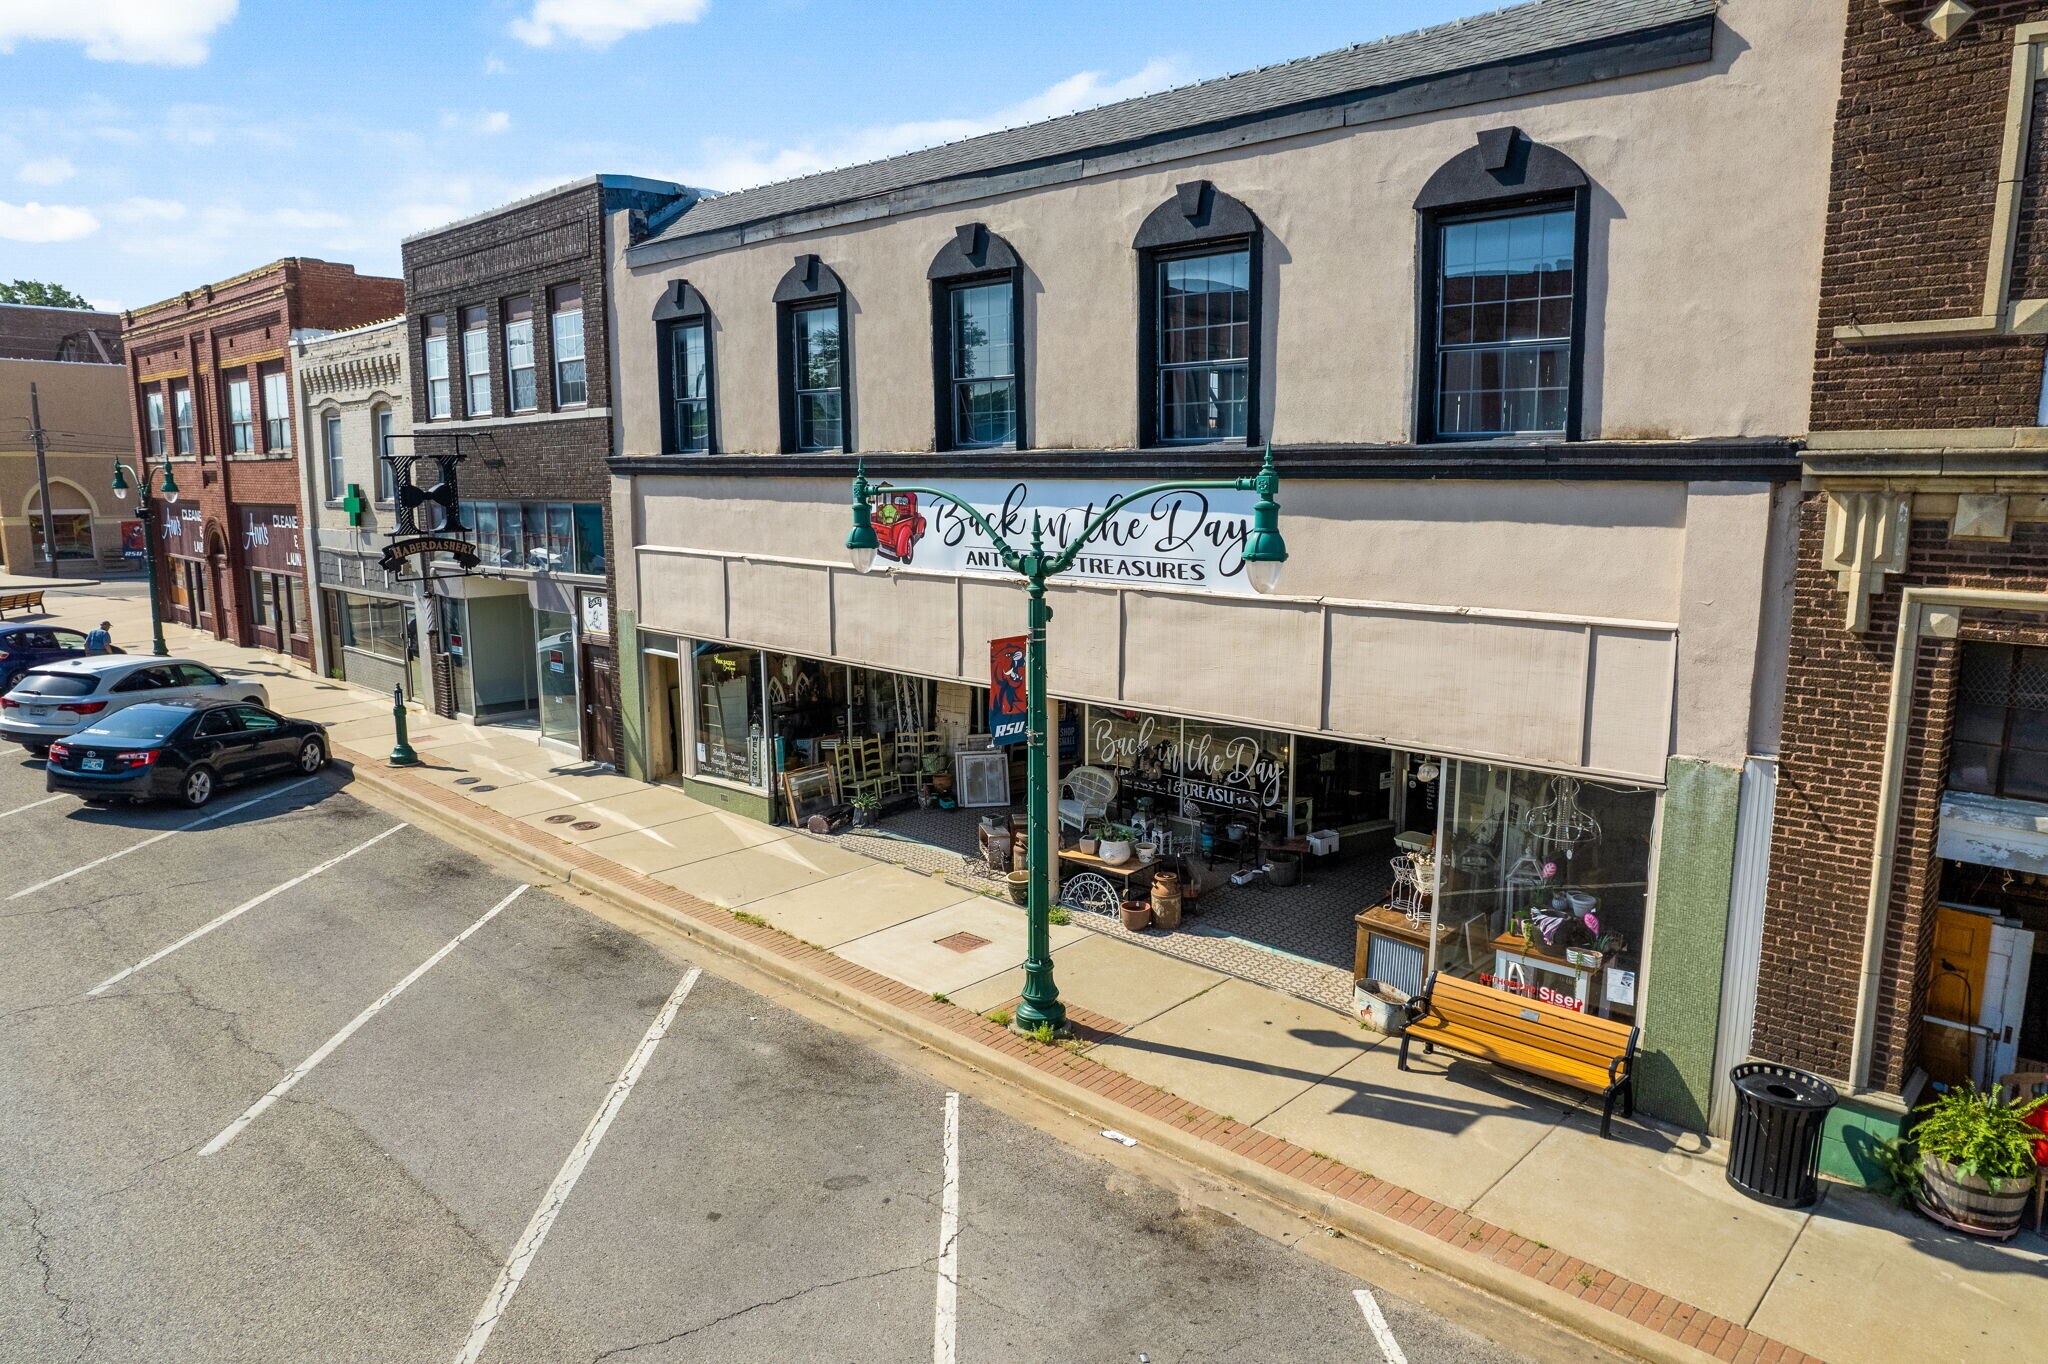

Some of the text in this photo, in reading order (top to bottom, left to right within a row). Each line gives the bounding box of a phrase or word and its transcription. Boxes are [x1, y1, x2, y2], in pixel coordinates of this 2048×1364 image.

[182, 509, 202, 521] CLEANE
[273, 514, 298, 528] CLEANE
[930, 483, 1026, 546] Back
[1066, 494, 1148, 546] the
[1151, 490, 1253, 577] Day
[391, 540, 474, 558] HABERDASHERY
[1076, 557, 1206, 581] TREASURES
[995, 721, 1025, 737] RSU
[751, 736, 759, 778] WELCOME
[1093, 717, 1284, 806] Back in the Day
[1184, 783, 1259, 808] TREASU
[1539, 986, 1581, 1008] Siser
